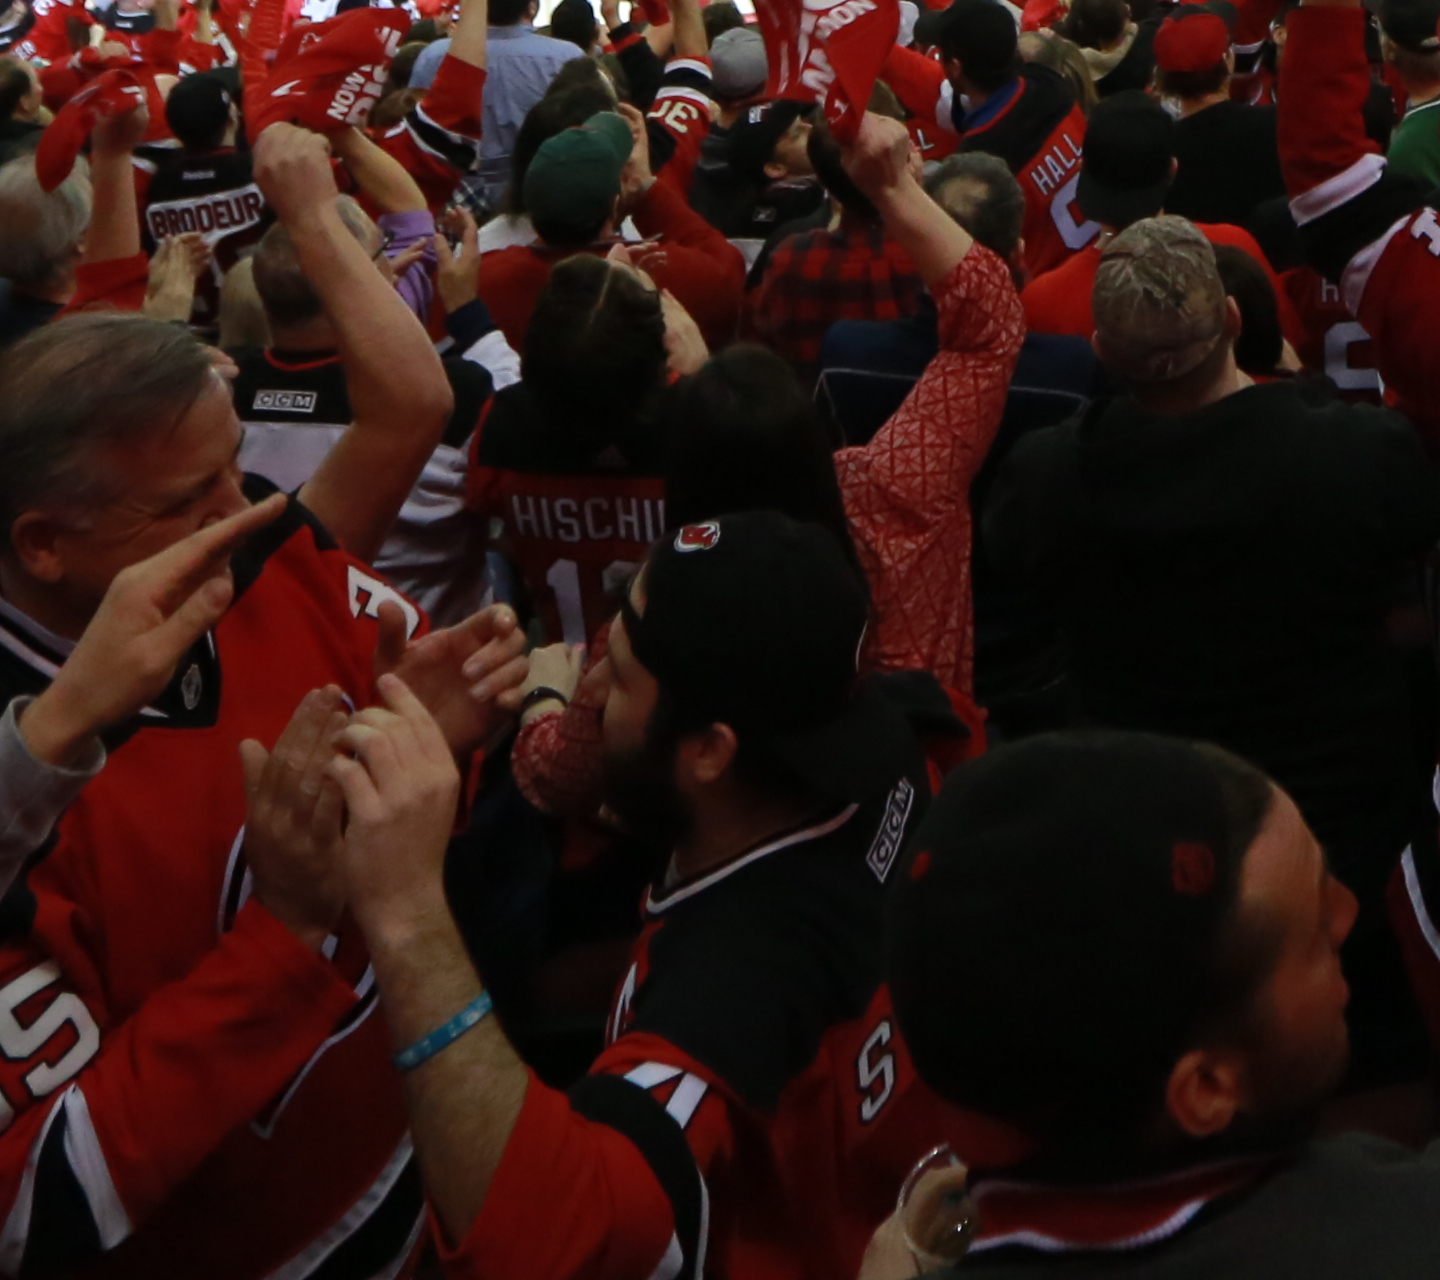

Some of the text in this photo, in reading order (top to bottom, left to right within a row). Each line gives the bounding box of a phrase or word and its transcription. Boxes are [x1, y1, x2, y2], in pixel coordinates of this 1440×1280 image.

[1030, 133, 1083, 196] HALL
[147, 188, 262, 238] BRODEUR
[253, 390, 316, 410] CCM
[514, 493, 666, 544] HISCHI
